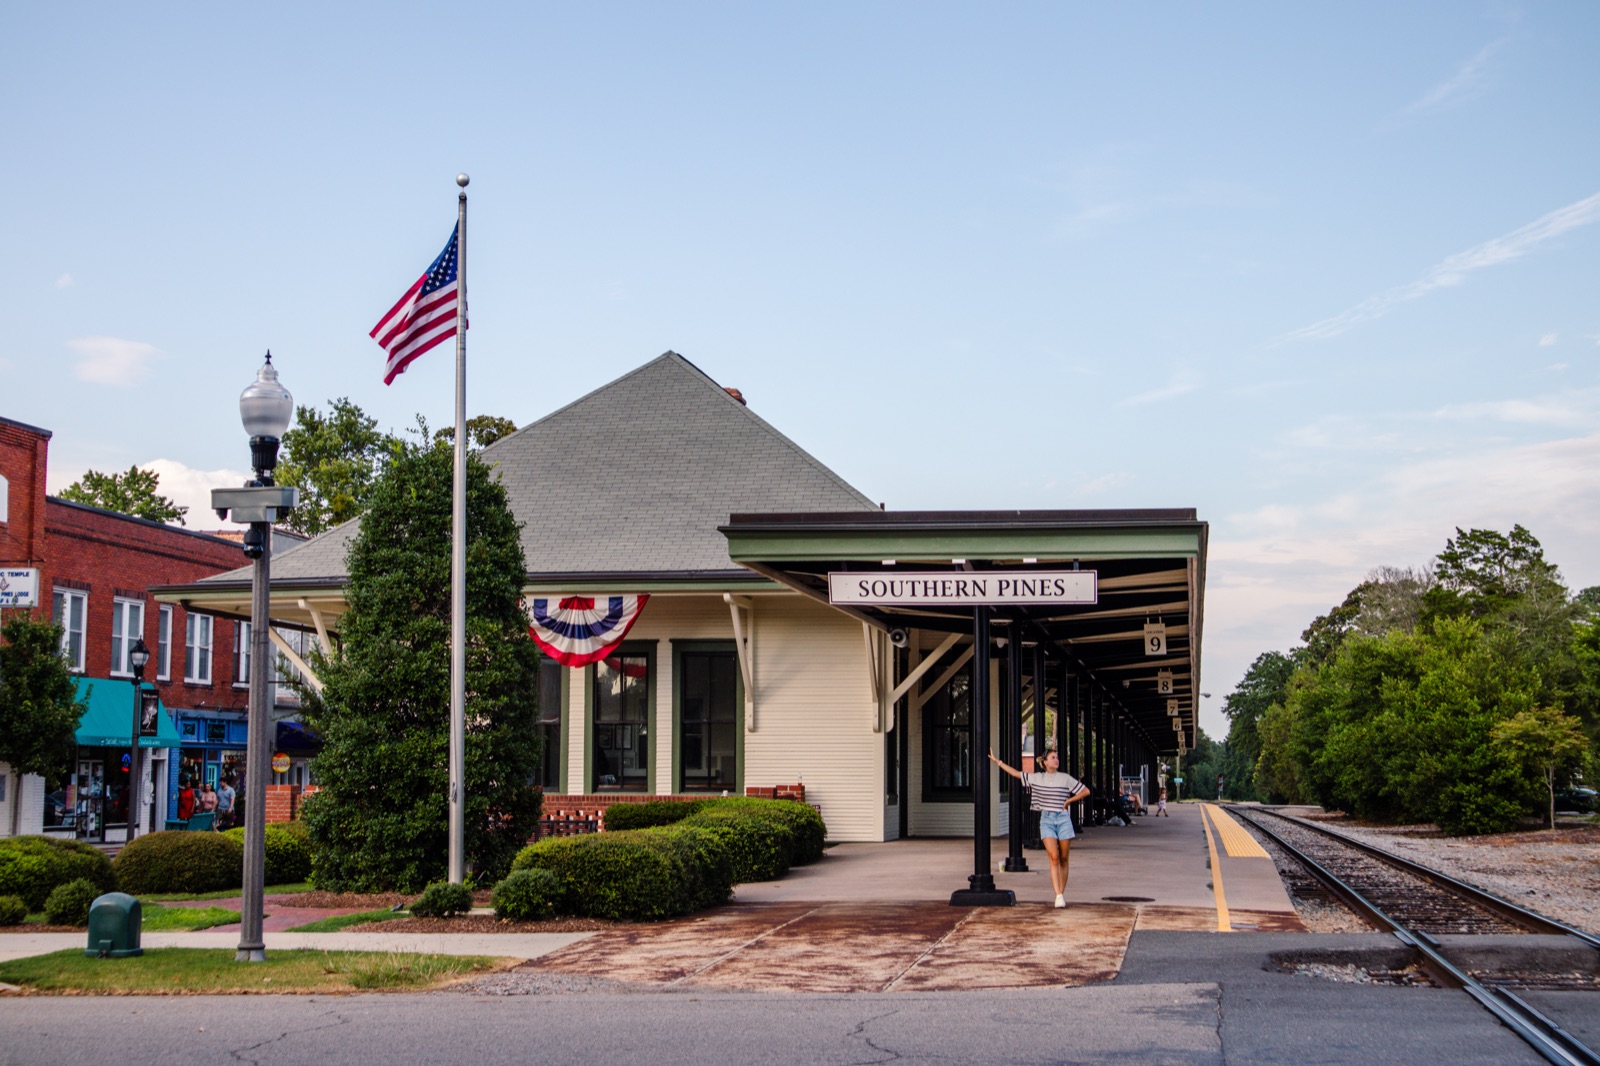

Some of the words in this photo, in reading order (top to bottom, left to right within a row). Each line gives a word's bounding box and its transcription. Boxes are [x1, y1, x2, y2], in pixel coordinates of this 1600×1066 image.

[858, 579, 988, 598] SOUTHERN
[997, 578, 1066, 597] PINES
[1150, 636, 1161, 652] 9
[1161, 680, 1169, 692] 8
[1170, 706, 1176, 714] 7
